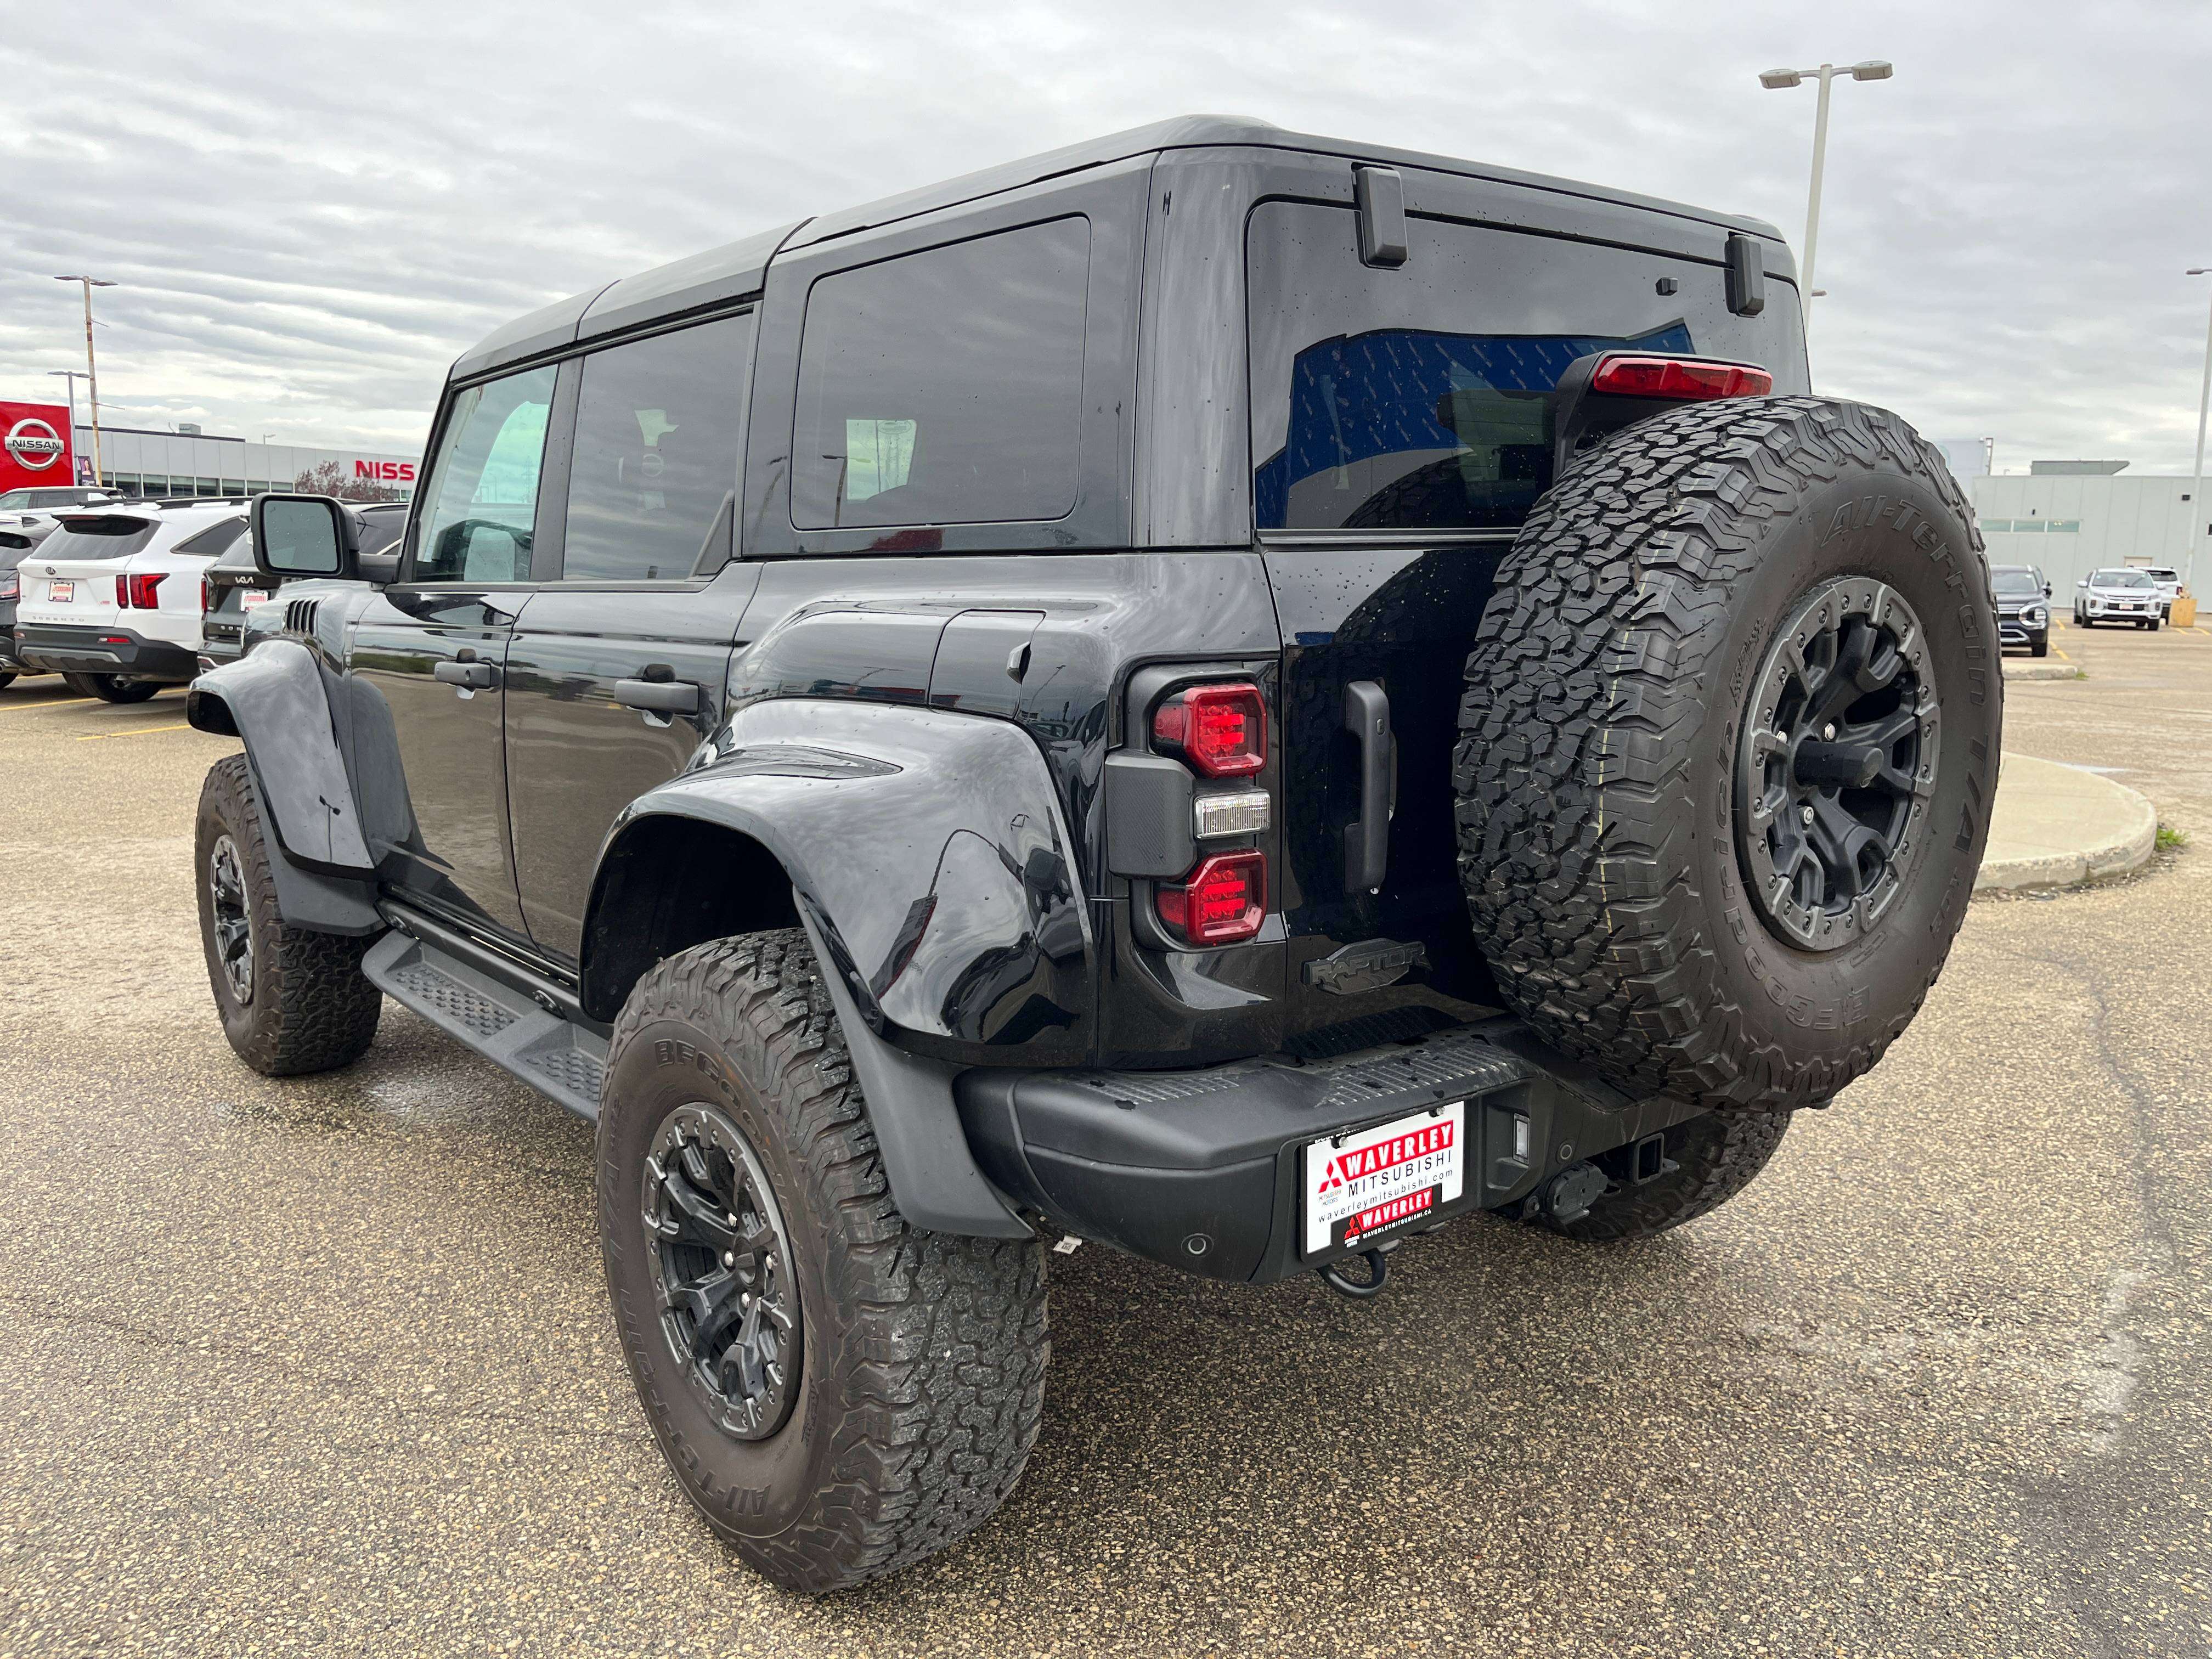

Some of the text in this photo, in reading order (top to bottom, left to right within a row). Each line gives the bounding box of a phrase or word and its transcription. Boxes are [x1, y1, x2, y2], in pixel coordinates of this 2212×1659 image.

[12, 439, 60, 449] NISSAN
[1311, 943, 1425, 985] RAPTOR
[1346, 1124, 1451, 1178] WAVERLEY
[1348, 1149, 1451, 1198] MITSUBISHI
[1319, 1169, 1453, 1223] waverleymitsubishi.com
[1362, 1190, 1431, 1228] WAVERLEY
